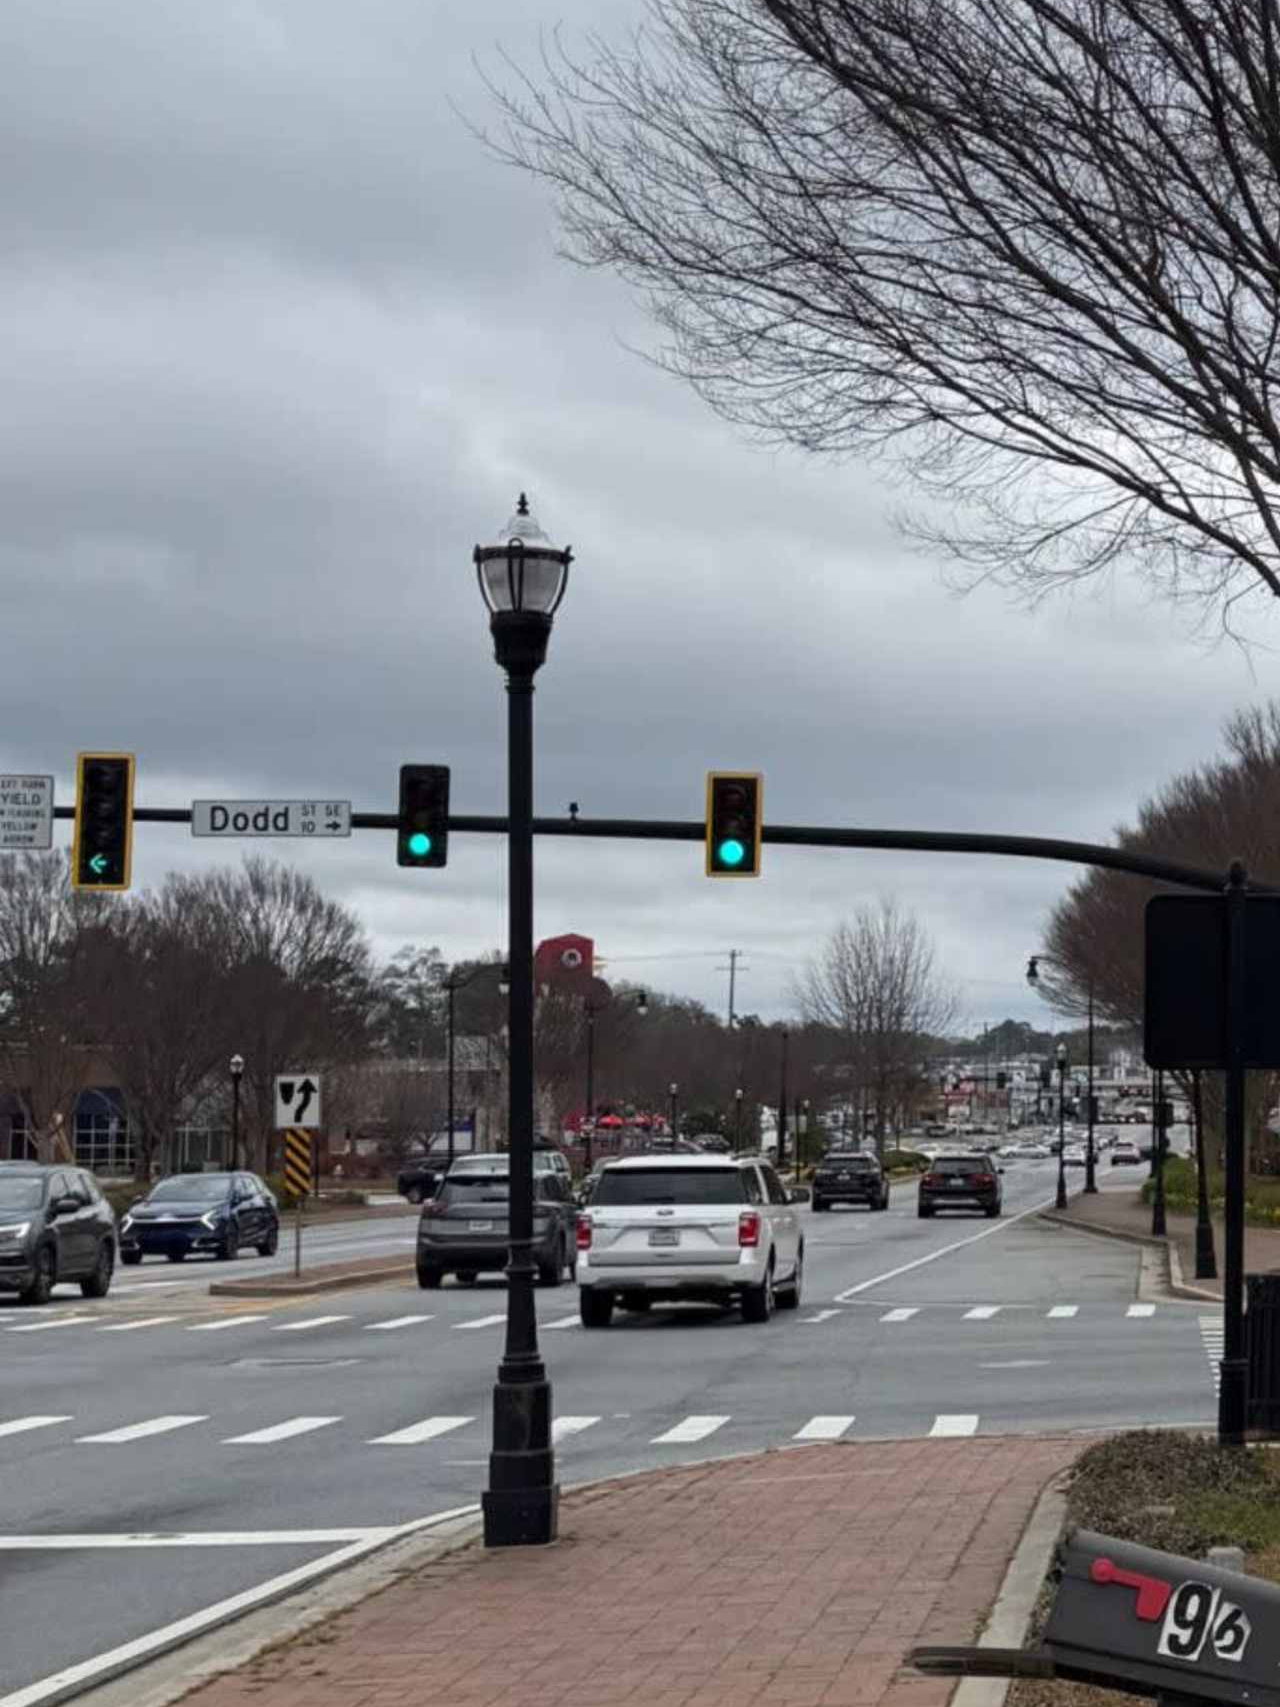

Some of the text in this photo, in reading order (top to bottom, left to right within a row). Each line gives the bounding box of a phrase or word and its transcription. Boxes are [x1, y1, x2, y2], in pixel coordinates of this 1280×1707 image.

[1, 793, 41, 805] YIELD
[210, 805, 289, 832] Dodd
[302, 804, 316, 816] ST
[1167, 1583, 1245, 1656] 96
